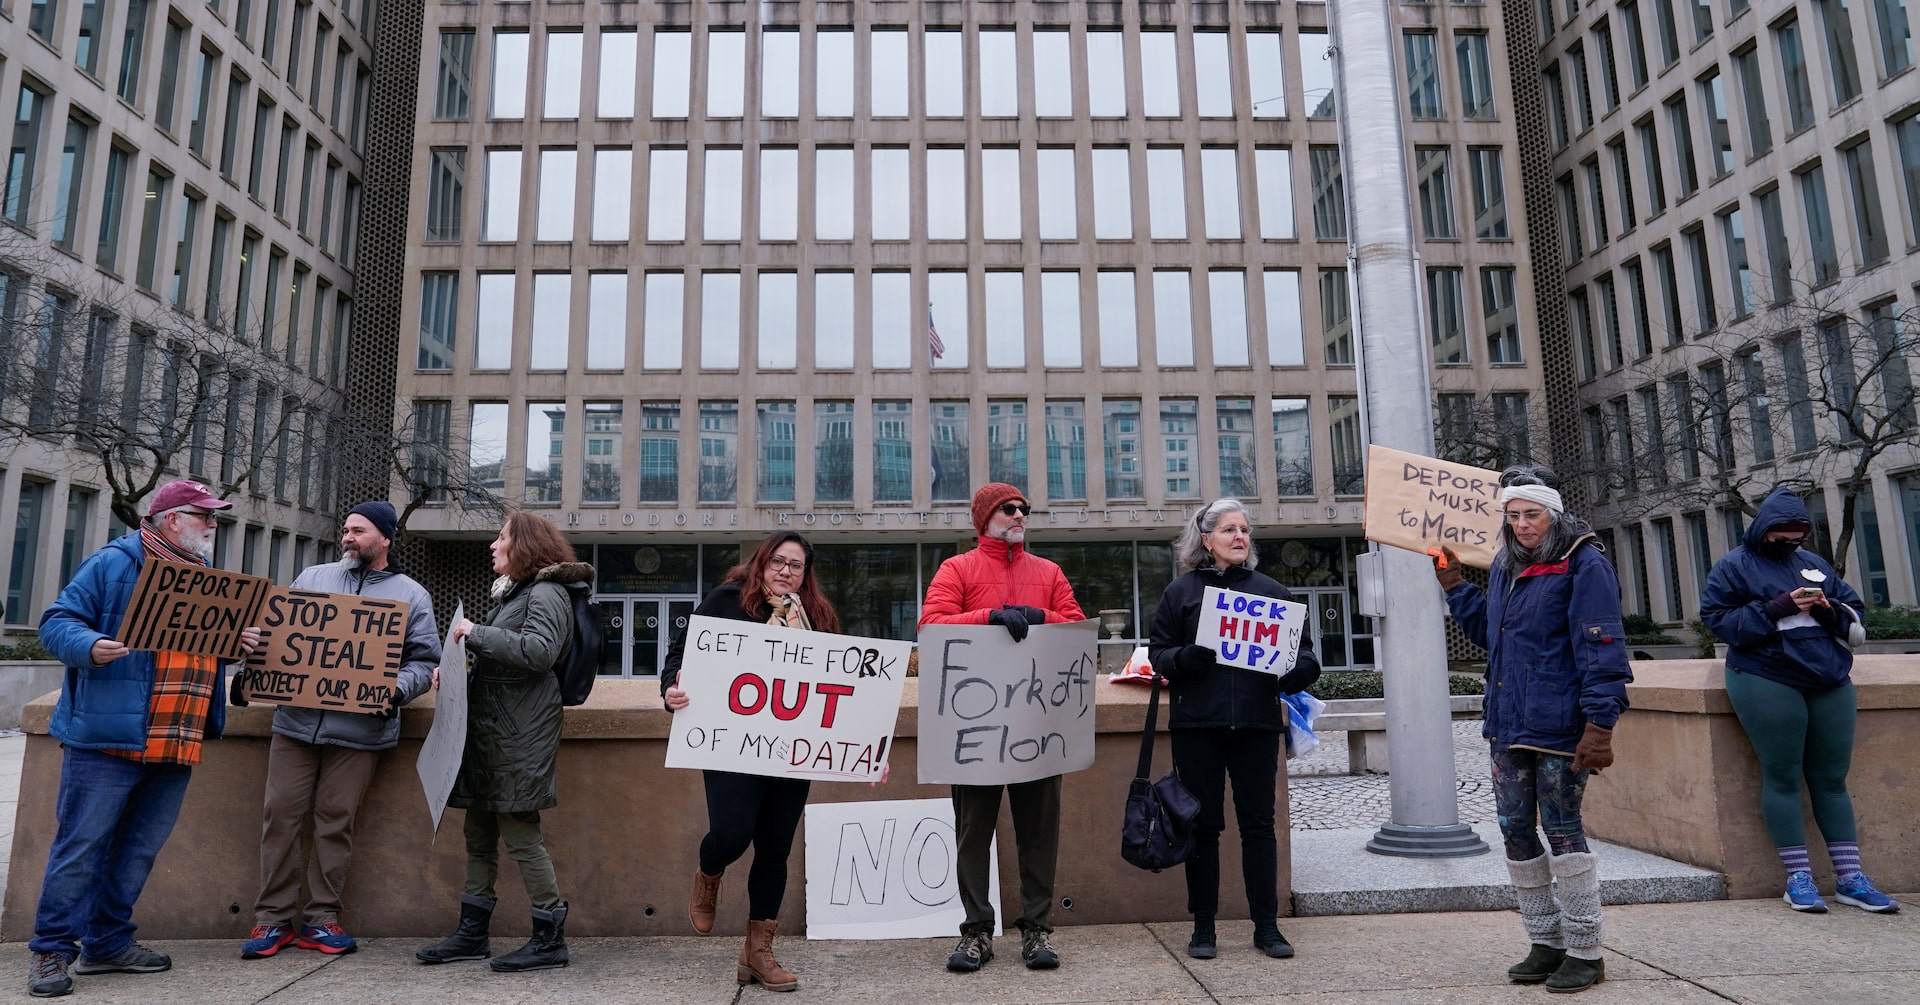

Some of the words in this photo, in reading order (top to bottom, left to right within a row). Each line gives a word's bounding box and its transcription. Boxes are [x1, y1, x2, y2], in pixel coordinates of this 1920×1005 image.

[1403, 463, 1501, 499] DEPORT
[1028, 508, 1191, 523] EDERAL
[1397, 508, 1418, 527] to
[1429, 489, 1490, 517] MUSK
[158, 566, 251, 600] DEPORT
[168, 602, 242, 631] ELON
[265, 595, 338, 631] STOP
[351, 609, 402, 637] THE
[1216, 593, 1287, 620] LOCK
[1219, 616, 1280, 646] HIM
[281, 633, 375, 670] STEAL
[697, 630, 749, 656] GET
[765, 640, 814, 665] THE
[826, 646, 897, 681] FORK
[1221, 641, 1280, 670] UP!
[1285, 628, 1299, 674] MUSK
[241, 667, 309, 695] PROTECT
[316, 677, 350, 700] OUR
[356, 682, 392, 704] DATA
[938, 639, 1046, 720] Fork
[728, 673, 855, 729] OUT
[687, 727, 728, 751] OF
[739, 733, 779, 759] MY
[789, 735, 888, 774] DATA!
[955, 725, 1066, 764] Elon
[830, 817, 960, 906] NO
